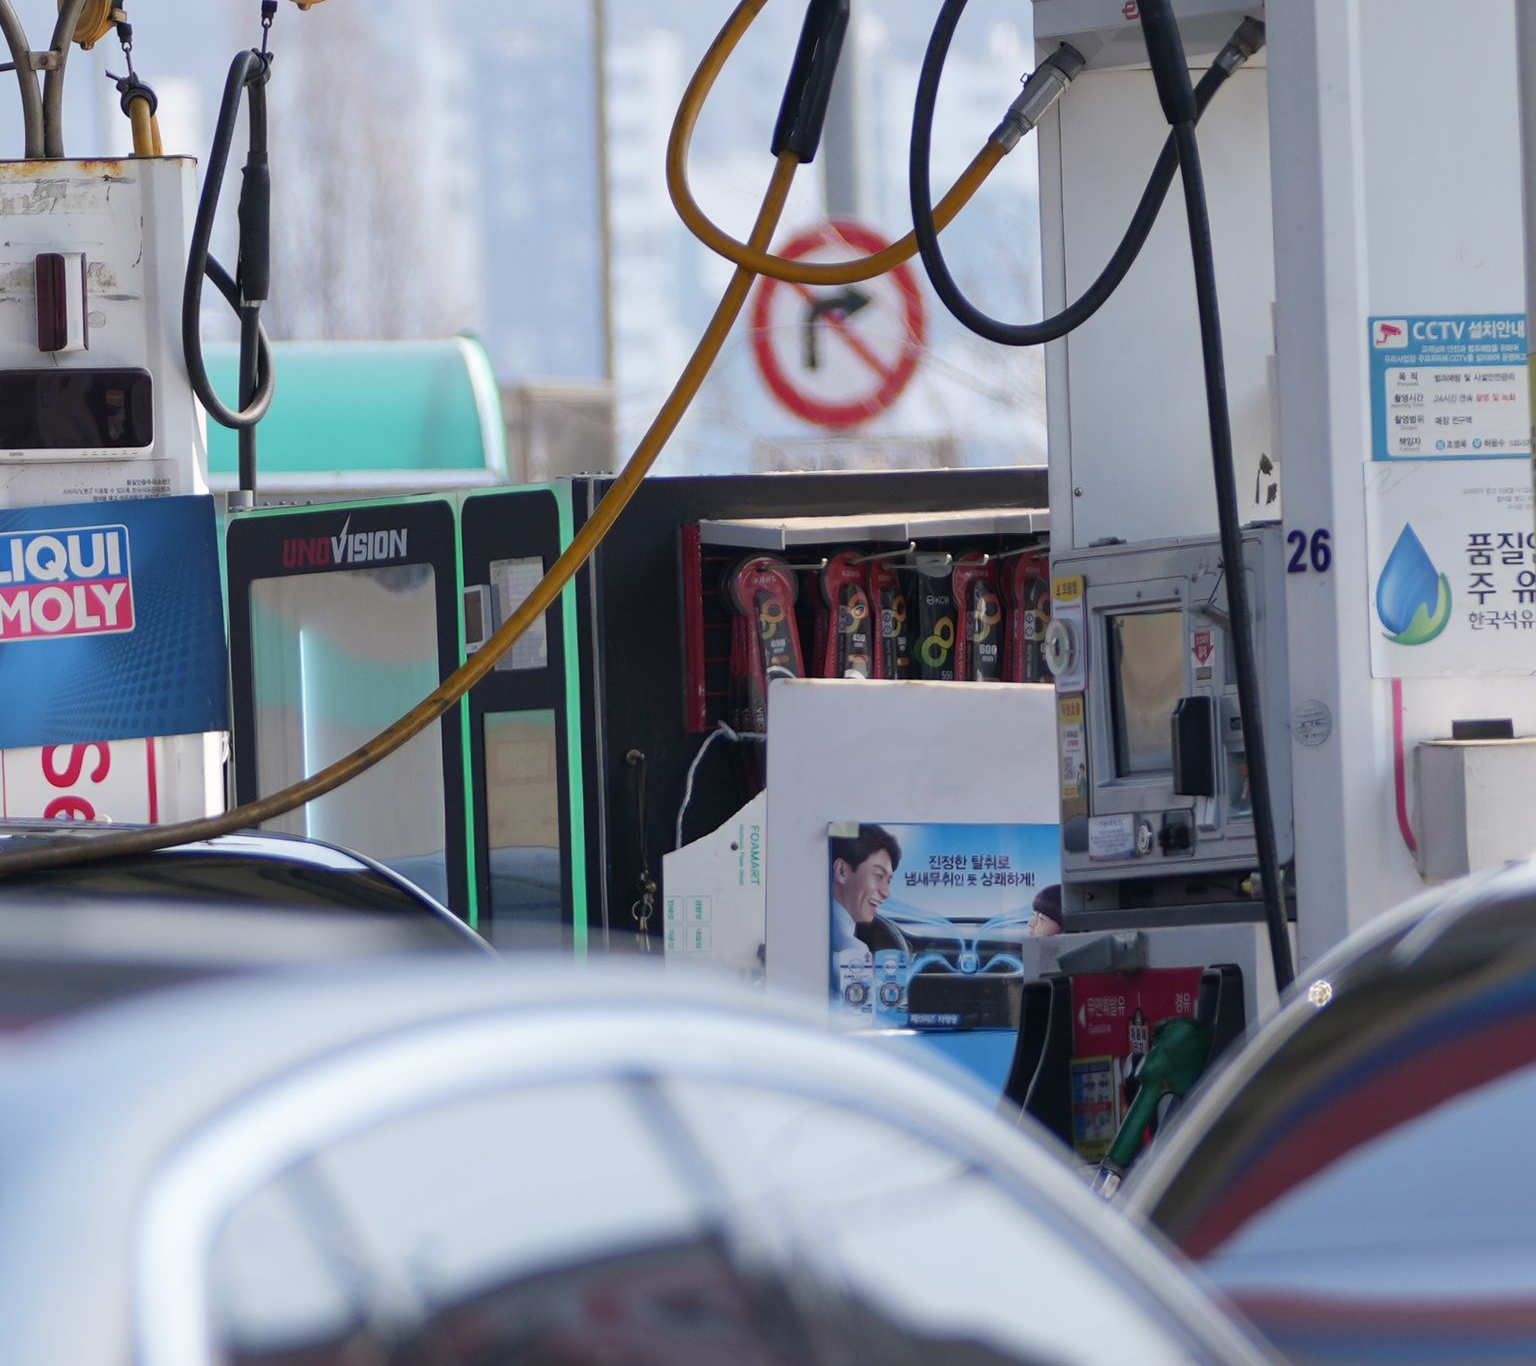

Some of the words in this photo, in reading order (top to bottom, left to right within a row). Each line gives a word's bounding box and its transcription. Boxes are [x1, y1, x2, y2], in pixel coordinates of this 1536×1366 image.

[1412, 321, 1465, 340] CCTV
[1468, 320, 1525, 338] 설치안내
[282, 528, 408, 568] UNOVISION
[1287, 528, 1332, 573] 26
[979, 644, 997, 655] 600
[750, 825, 760, 886] FOAMART
[928, 854, 967, 871] 진정한
[971, 854, 1011, 870] 탈취로
[904, 871, 964, 887] 냄새무취인
[966, 873, 978, 886] 듯
[980, 871, 1035, 887] 상쾌하게!
[1175, 992, 1191, 1013] 경유
